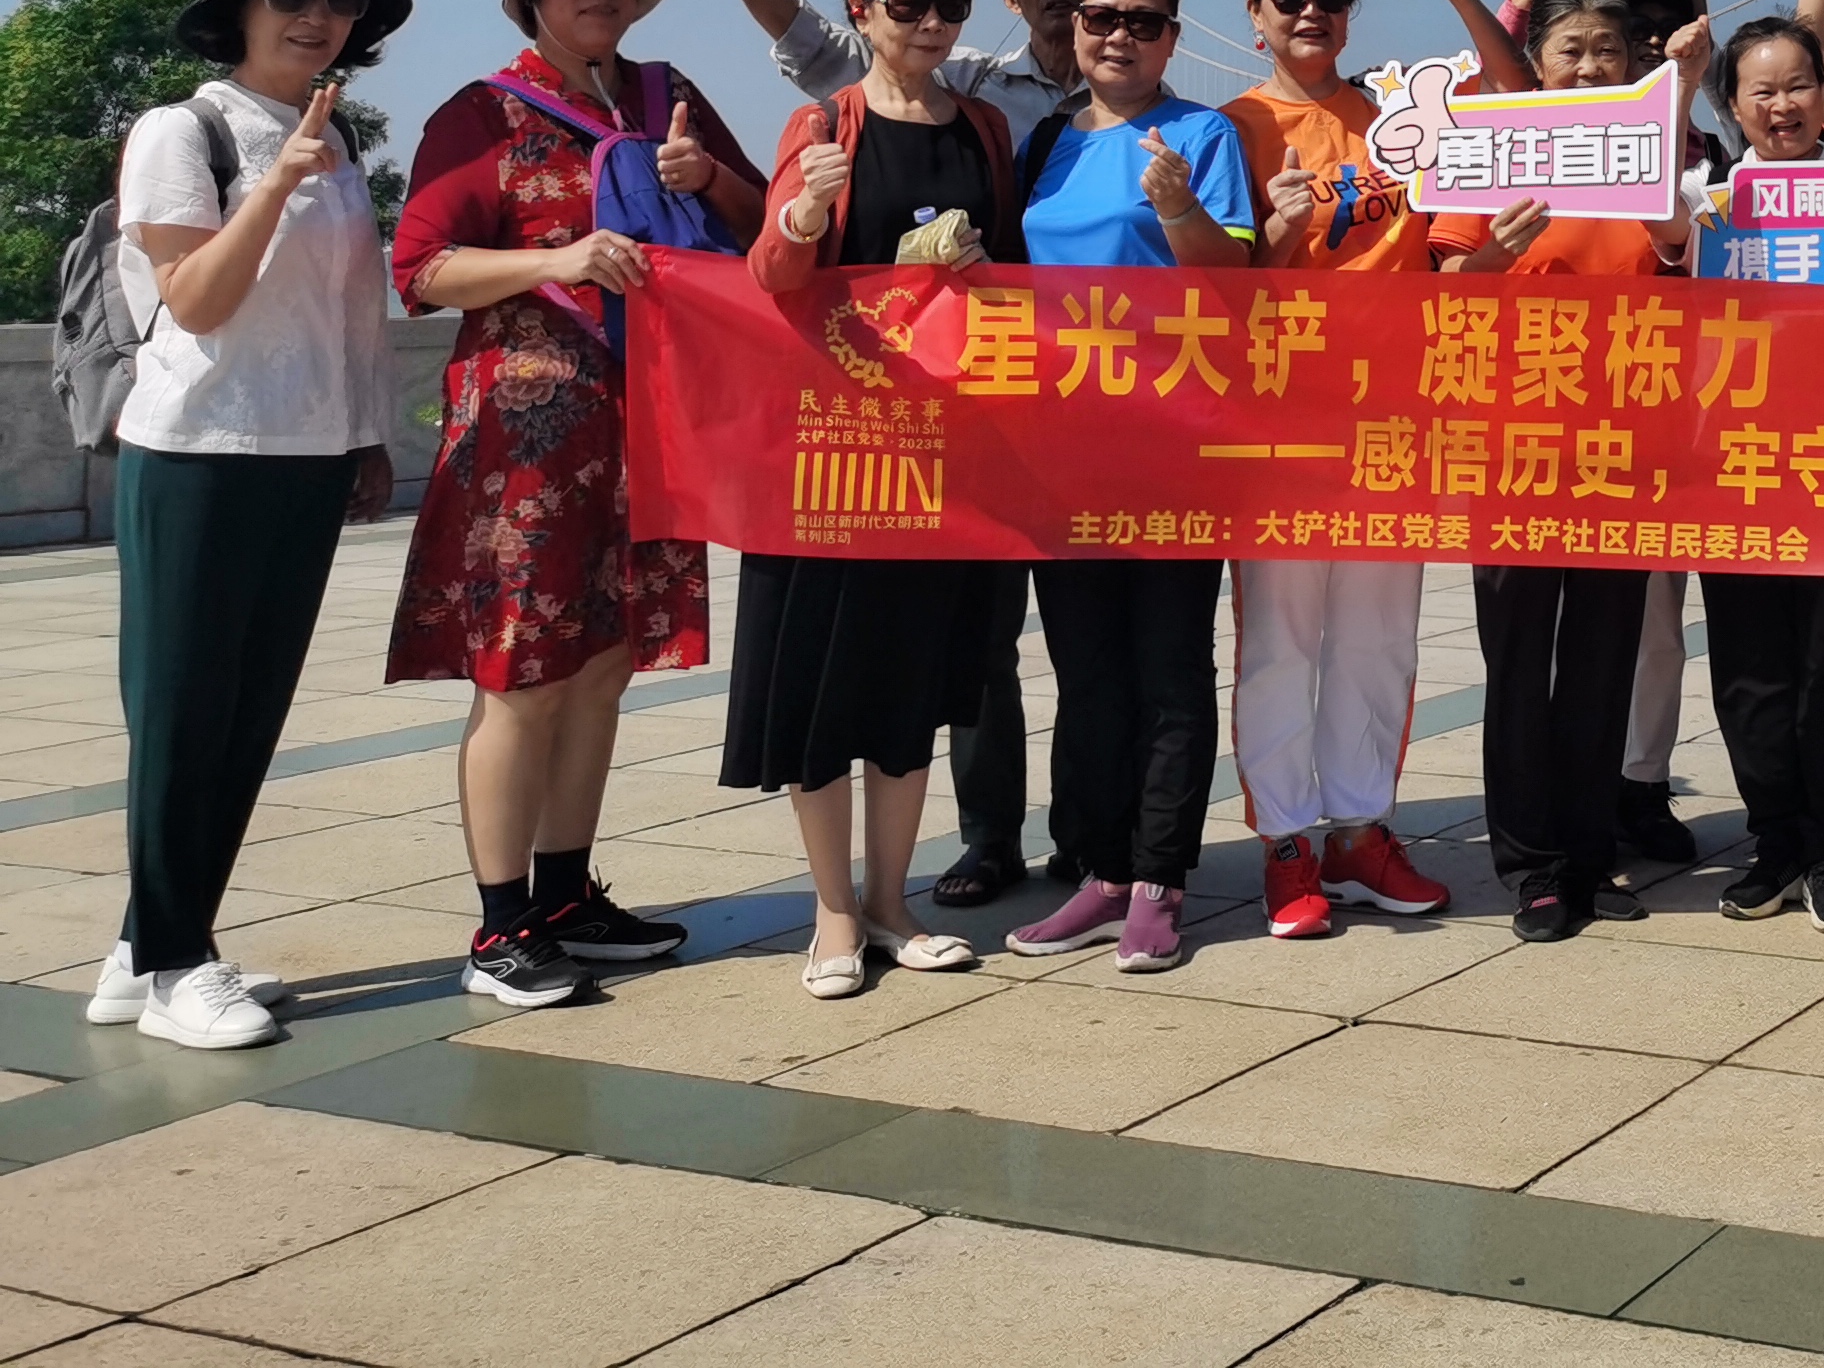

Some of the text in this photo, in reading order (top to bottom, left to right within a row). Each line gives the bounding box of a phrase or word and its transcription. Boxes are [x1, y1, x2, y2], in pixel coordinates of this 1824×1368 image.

[1436, 121, 1663, 191] 勇往直前
[1309, 169, 1404, 204] UPRE
[1347, 187, 1412, 227] LOV
[955, 285, 1772, 410] 星光大铲，凝聚栋力
[798, 389, 945, 423] 民生微实事
[797, 414, 945, 435] Min Sheng Wei Shi Shi
[794, 514, 941, 530] 南山区新时代文明实践
[795, 530, 851, 545] 系列活动
[1491, 516, 1808, 564] 大铲社区居民委员会
